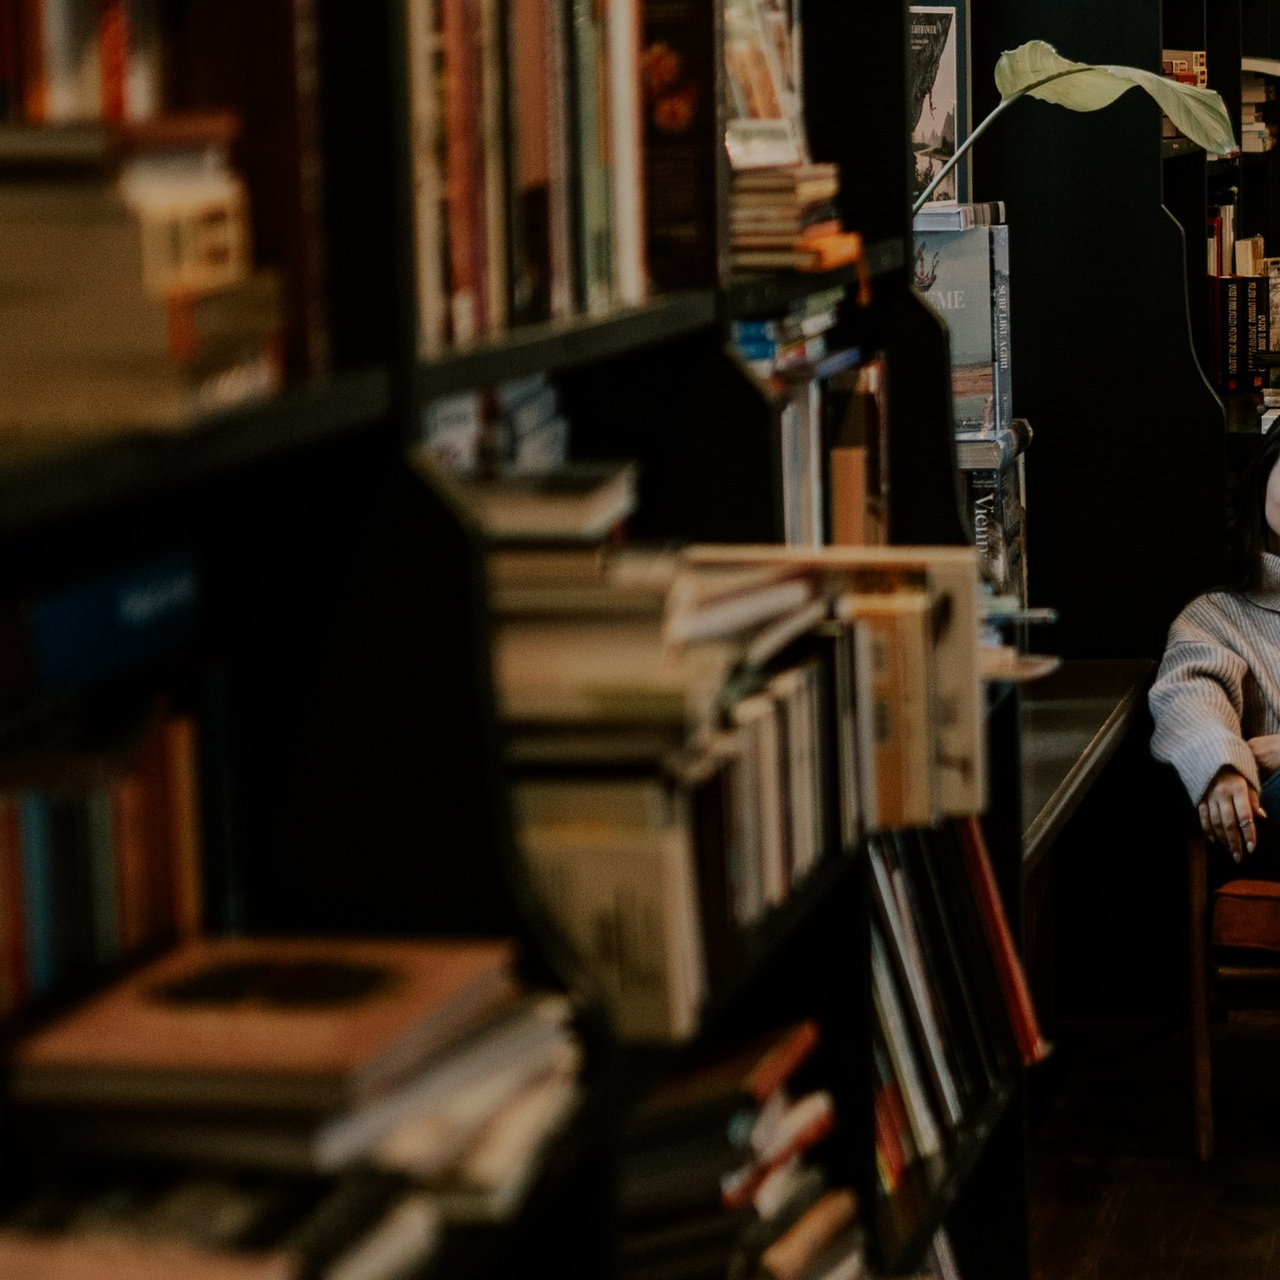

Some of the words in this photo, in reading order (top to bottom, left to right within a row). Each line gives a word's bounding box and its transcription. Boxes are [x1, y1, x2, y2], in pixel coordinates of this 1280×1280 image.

[999, 284, 1007, 310] SURF
[1000, 313, 1008, 338] LIKE
[974, 492, 995, 554] Vienn
